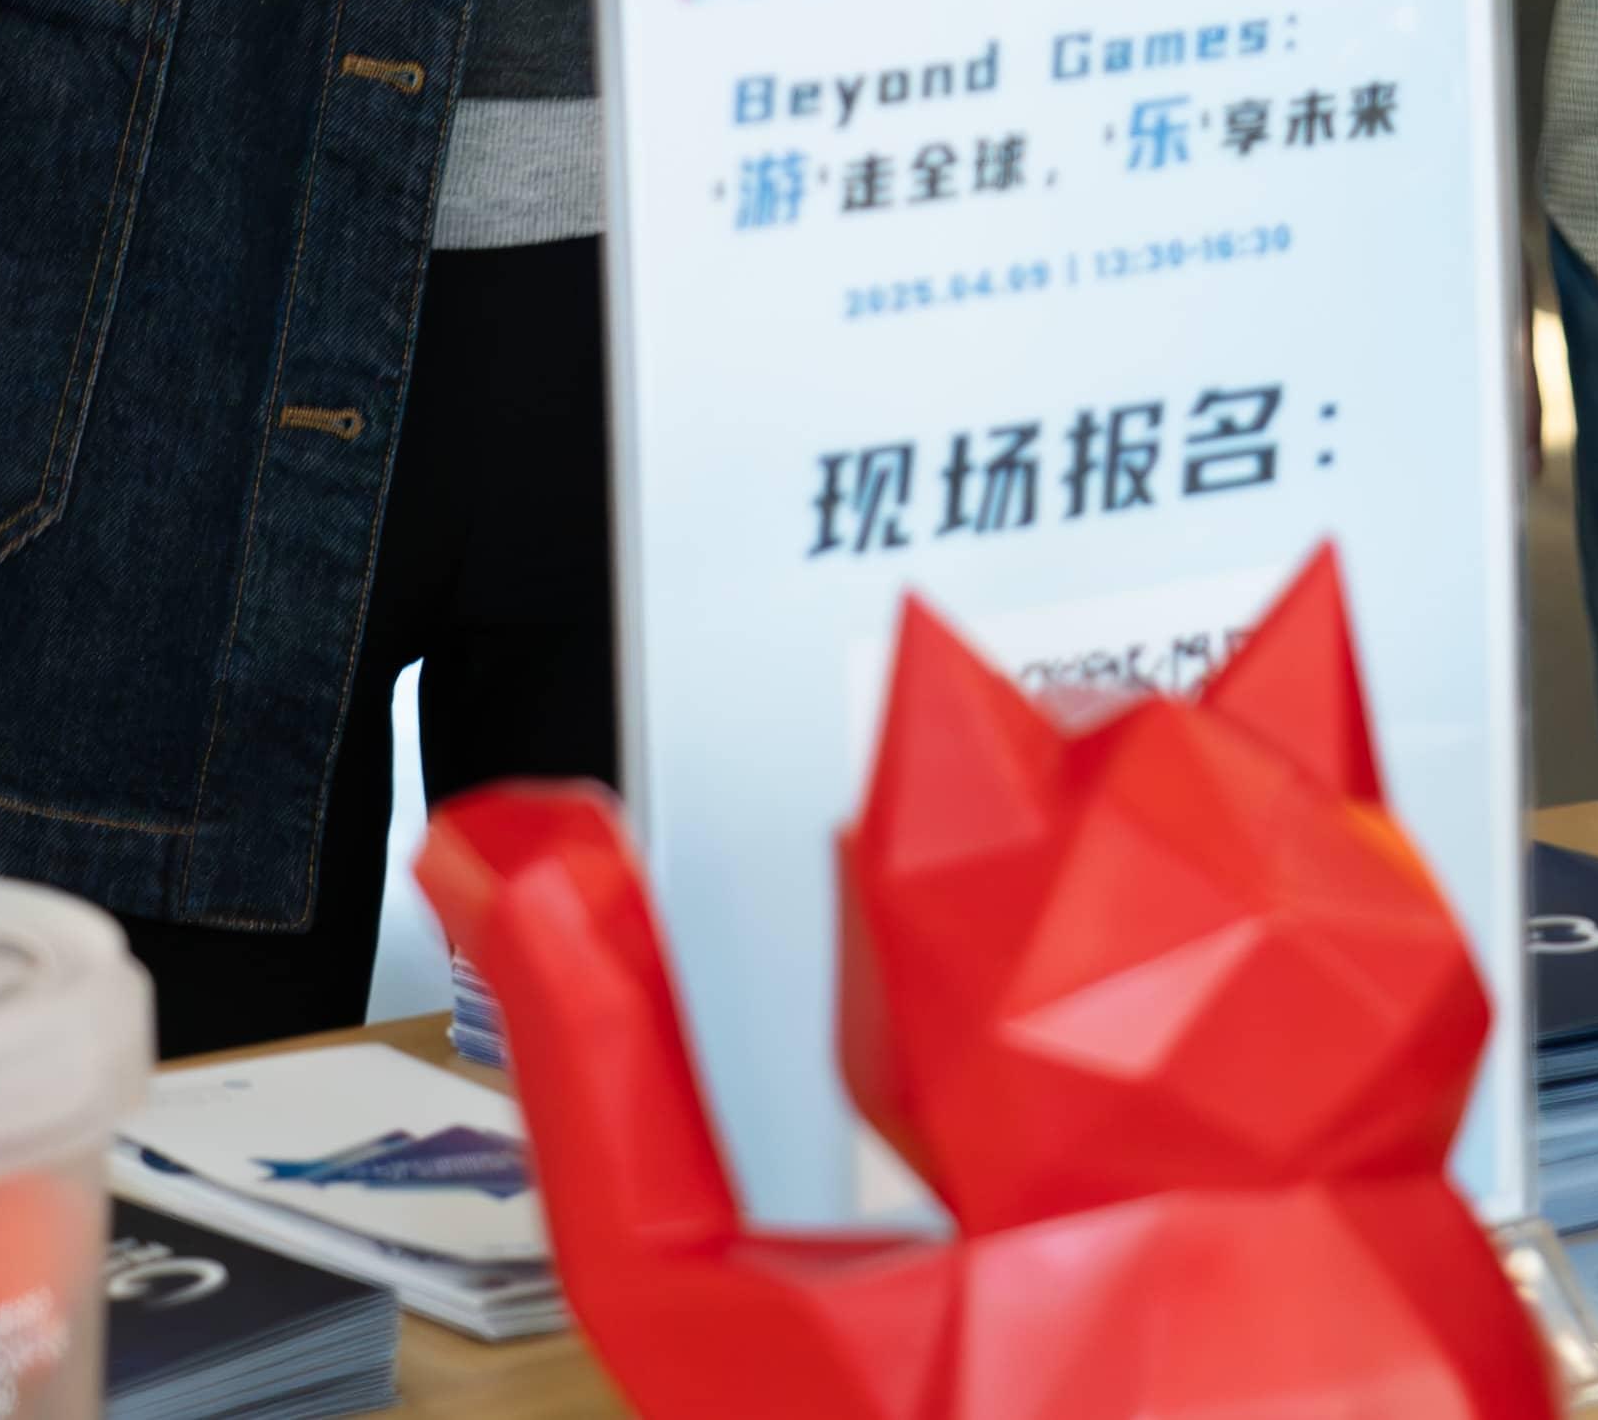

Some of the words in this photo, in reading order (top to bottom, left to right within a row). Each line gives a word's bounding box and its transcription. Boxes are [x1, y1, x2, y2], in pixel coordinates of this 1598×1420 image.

[733, 37, 1000, 129] Beyond
[1052, 14, 1298, 81] Games:
[845, 259, 1051, 319] 2025.04.09
